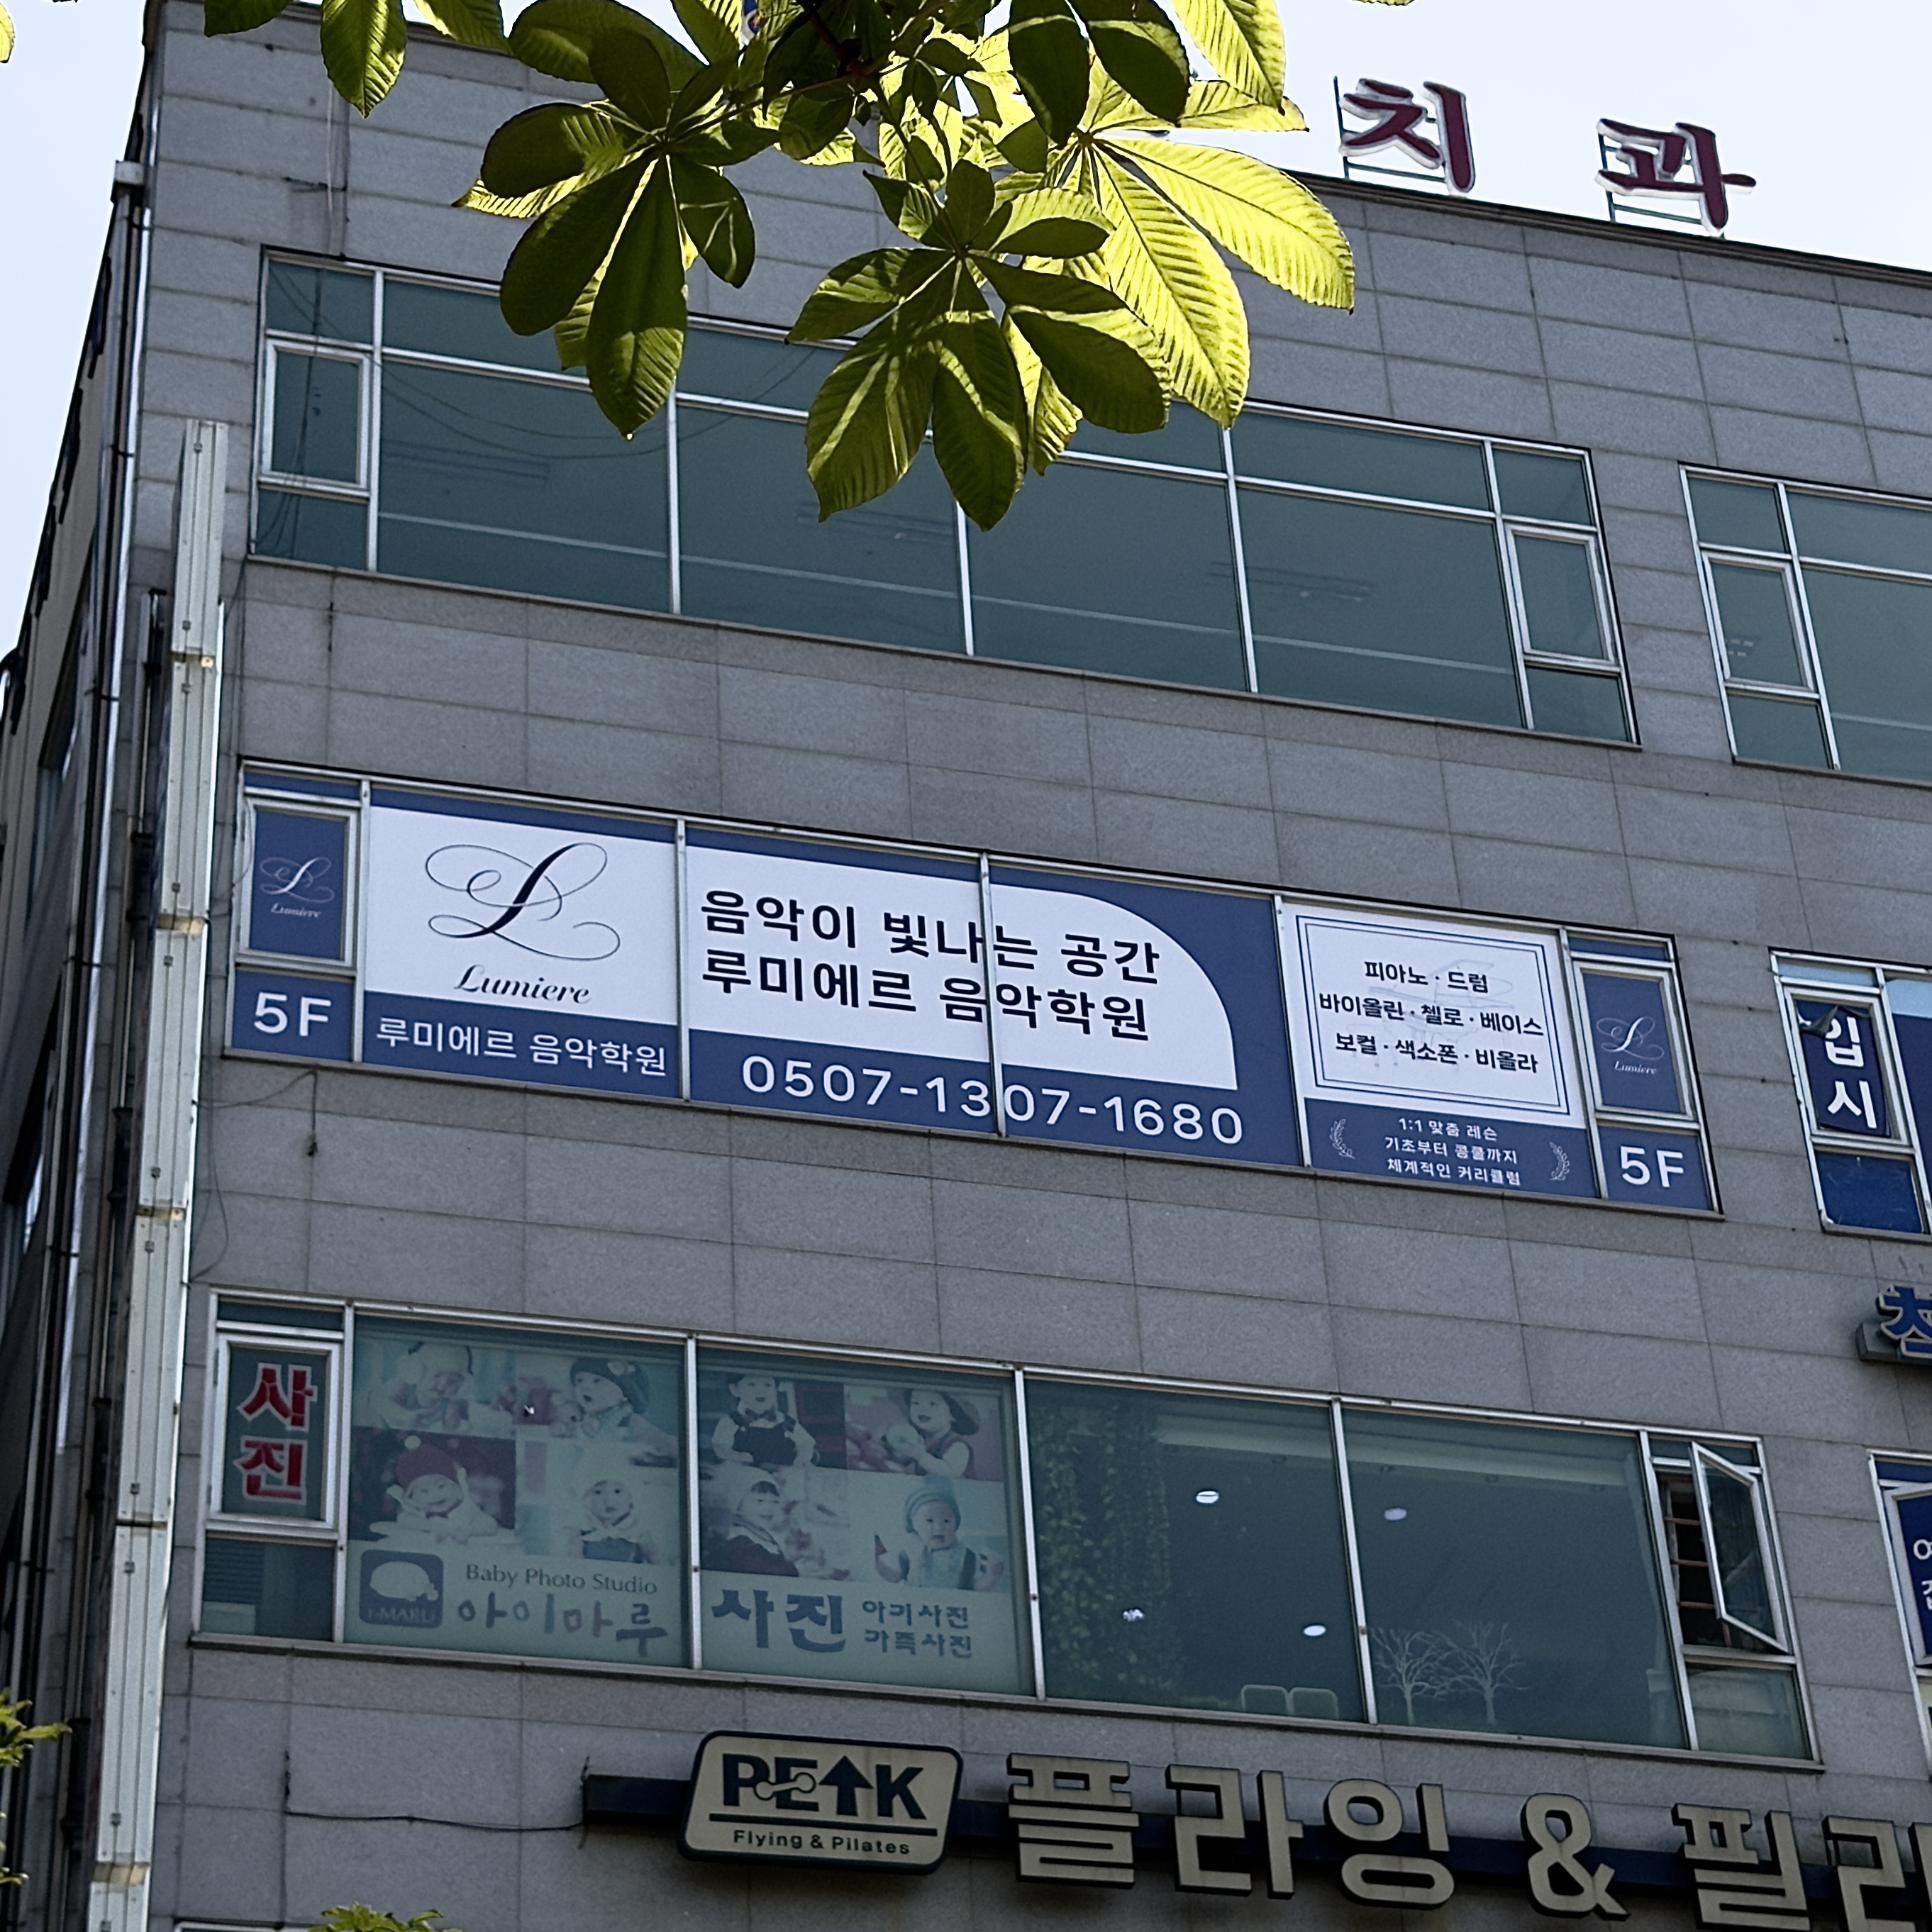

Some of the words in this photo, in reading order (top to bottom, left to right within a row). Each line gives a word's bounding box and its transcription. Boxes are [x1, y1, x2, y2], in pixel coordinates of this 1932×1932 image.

[1340, 78, 1756, 237] 치과
[701, 889, 856, 949] 음악이
[883, 911, 1039, 971] 빛나는
[1060, 933, 1160, 985] 공간
[702, 948, 917, 1013] 루미에르
[939, 977, 1150, 1043] 음악학원
[1364, 961, 1428, 985] 피아노
[1448, 971, 1489, 993] 드럼
[253, 992, 332, 1038] 5F
[1319, 993, 1405, 1021] 바이올린
[1421, 1004, 1464, 1027] 첼로
[1479, 1011, 1544, 1036] 베이스
[376, 1016, 516, 1059] 루미에르
[529, 1033, 667, 1077] 음악학원
[1336, 1033, 1378, 1055] 보컬
[1395, 1040, 1458, 1065] 색소폰
[1475, 1049, 1538, 1073] 비올라
[742, 1055, 1244, 1146] 0507-1307-1680
[1384, 1136, 1448, 1157] 기초부터
[1399, 1118, 1423, 1133] 1:1
[1428, 1120, 1460, 1138] 맞춤
[1466, 1125, 1498, 1142] 레슨
[1387, 1157, 1452, 1179] 체계적인
[1458, 1165, 1521, 1187] 커리큘럼
[1620, 1145, 1686, 1189] 5F
[234, 1362, 318, 1504] 사진
[465, 1563, 518, 1589] Baby
[525, 1568, 586, 1590] Photo
[592, 1572, 657, 1595] Studio
[458, 1592, 668, 1658] 아이마루
[711, 1589, 846, 1653] 사진
[862, 1600, 970, 1629] 아기사진
[864, 1629, 972, 1659] 가족사진
[733, 1829, 804, 1850] Flying
[810, 1833, 824, 1850] &
[832, 1836, 911, 1855] Pilates
[1006, 1753, 1455, 1910] 플라잉
[1520, 1792, 1630, 1920] &
